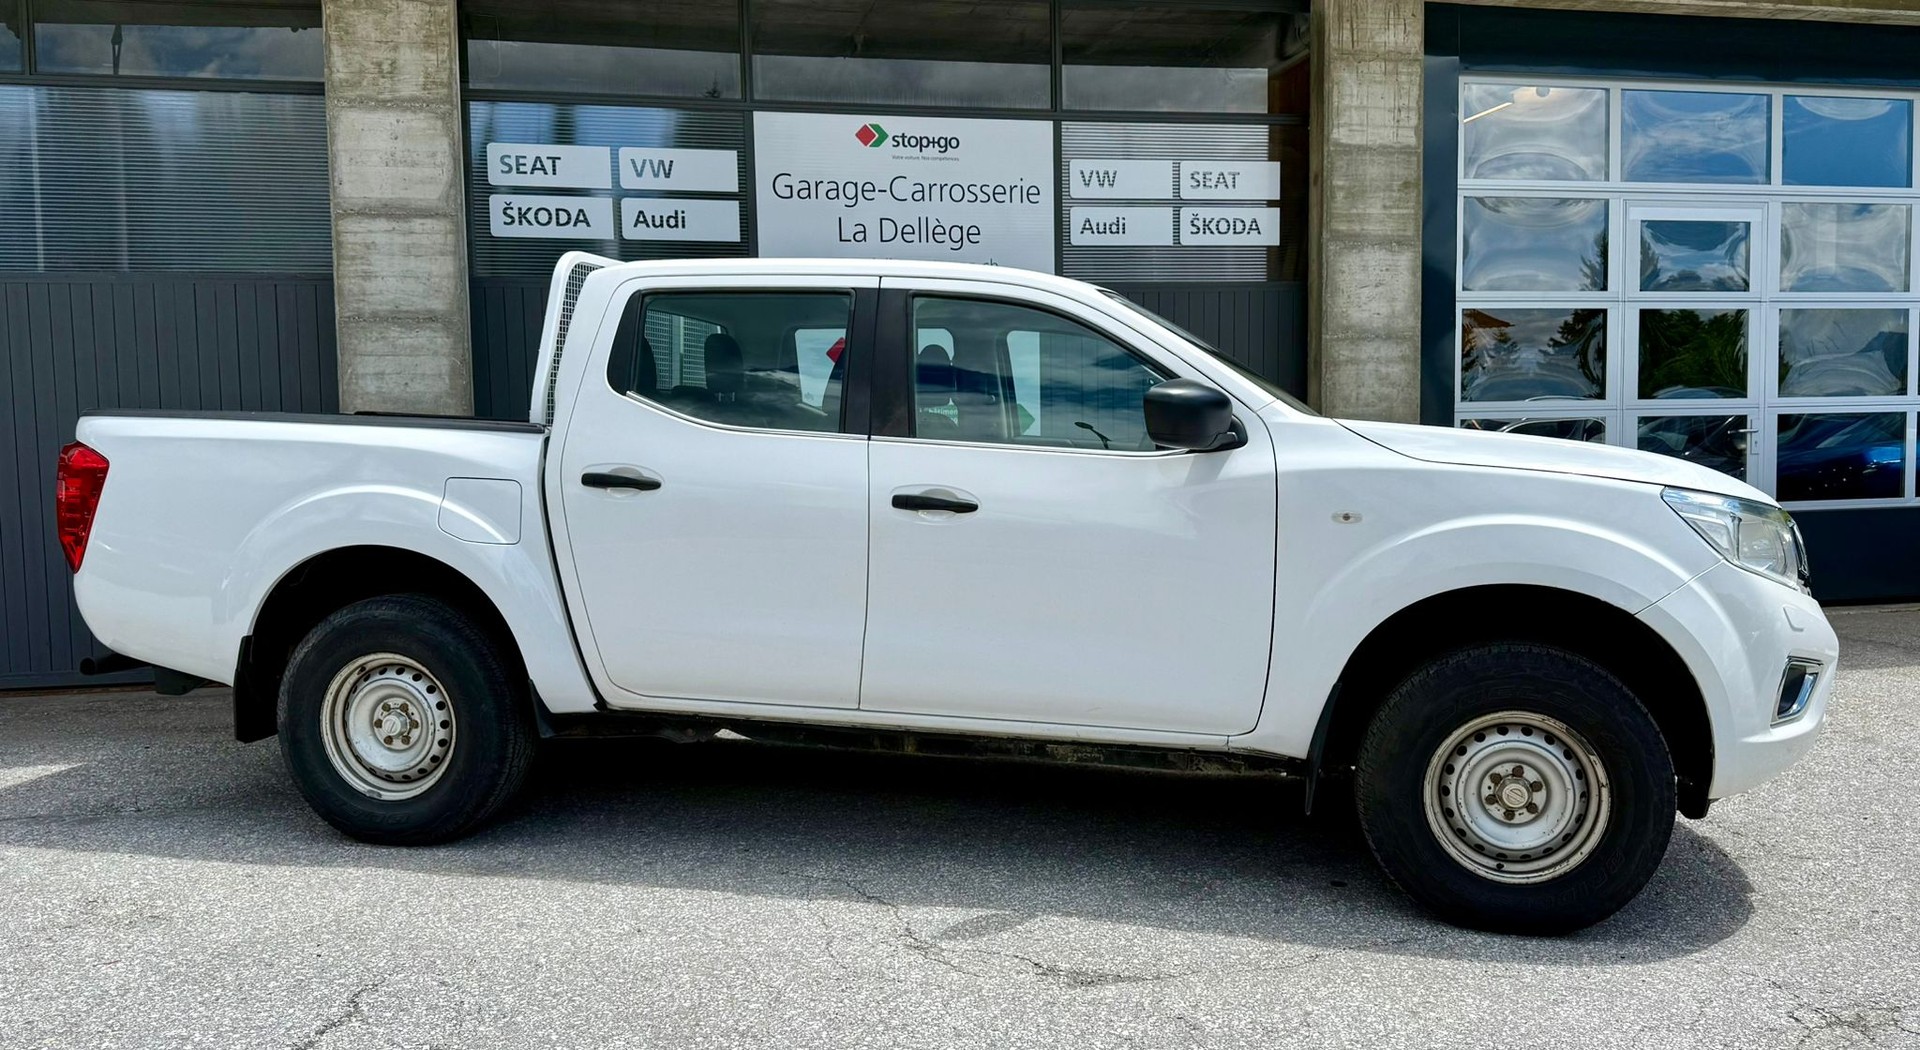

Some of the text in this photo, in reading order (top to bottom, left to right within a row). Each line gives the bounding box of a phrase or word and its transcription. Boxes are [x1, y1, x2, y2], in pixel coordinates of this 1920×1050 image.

[892, 132, 960, 153] stop+go
[500, 154, 561, 176] SEAT
[630, 158, 674, 179] VW
[772, 172, 1041, 207] Garage-Carrosserie
[1080, 170, 1118, 188] VW
[1190, 171, 1240, 190] SEAT
[502, 202, 591, 228] ŠKODA
[633, 210, 686, 229] Audi
[1080, 216, 1126, 235] Audi
[1190, 213, 1261, 235] ŠKODA
[838, 217, 981, 250] La Dellège
